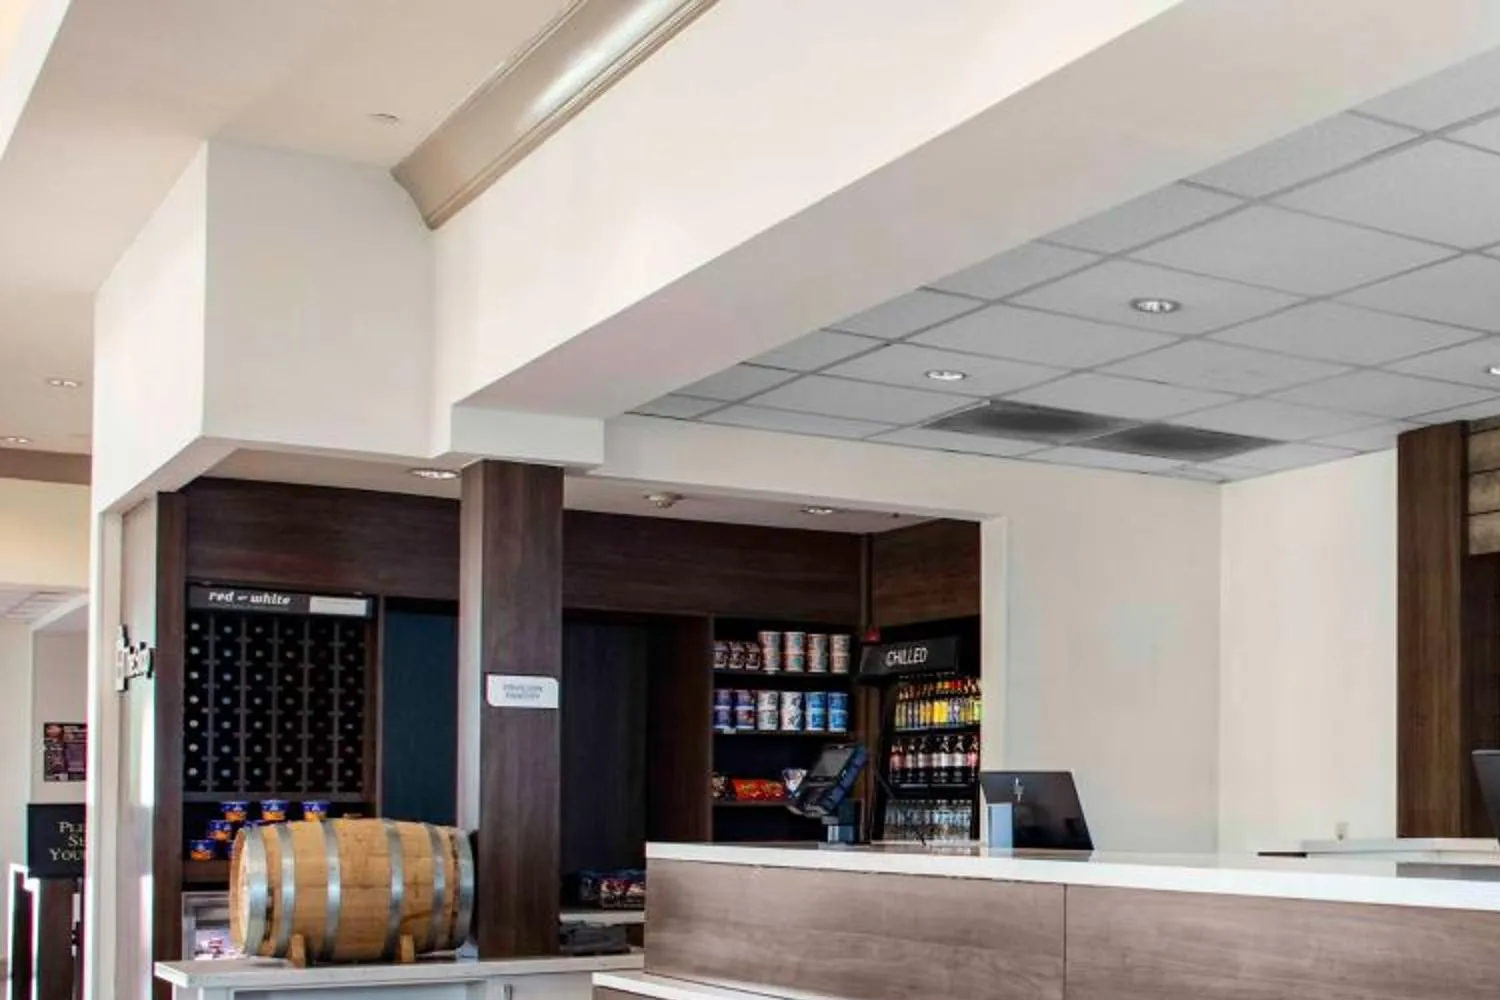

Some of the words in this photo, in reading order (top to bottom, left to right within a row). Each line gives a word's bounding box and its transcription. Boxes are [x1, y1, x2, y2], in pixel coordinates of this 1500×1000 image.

[208, 591, 234, 602] red
[250, 592, 291, 606] white
[886, 647, 928, 667] CHILLED
